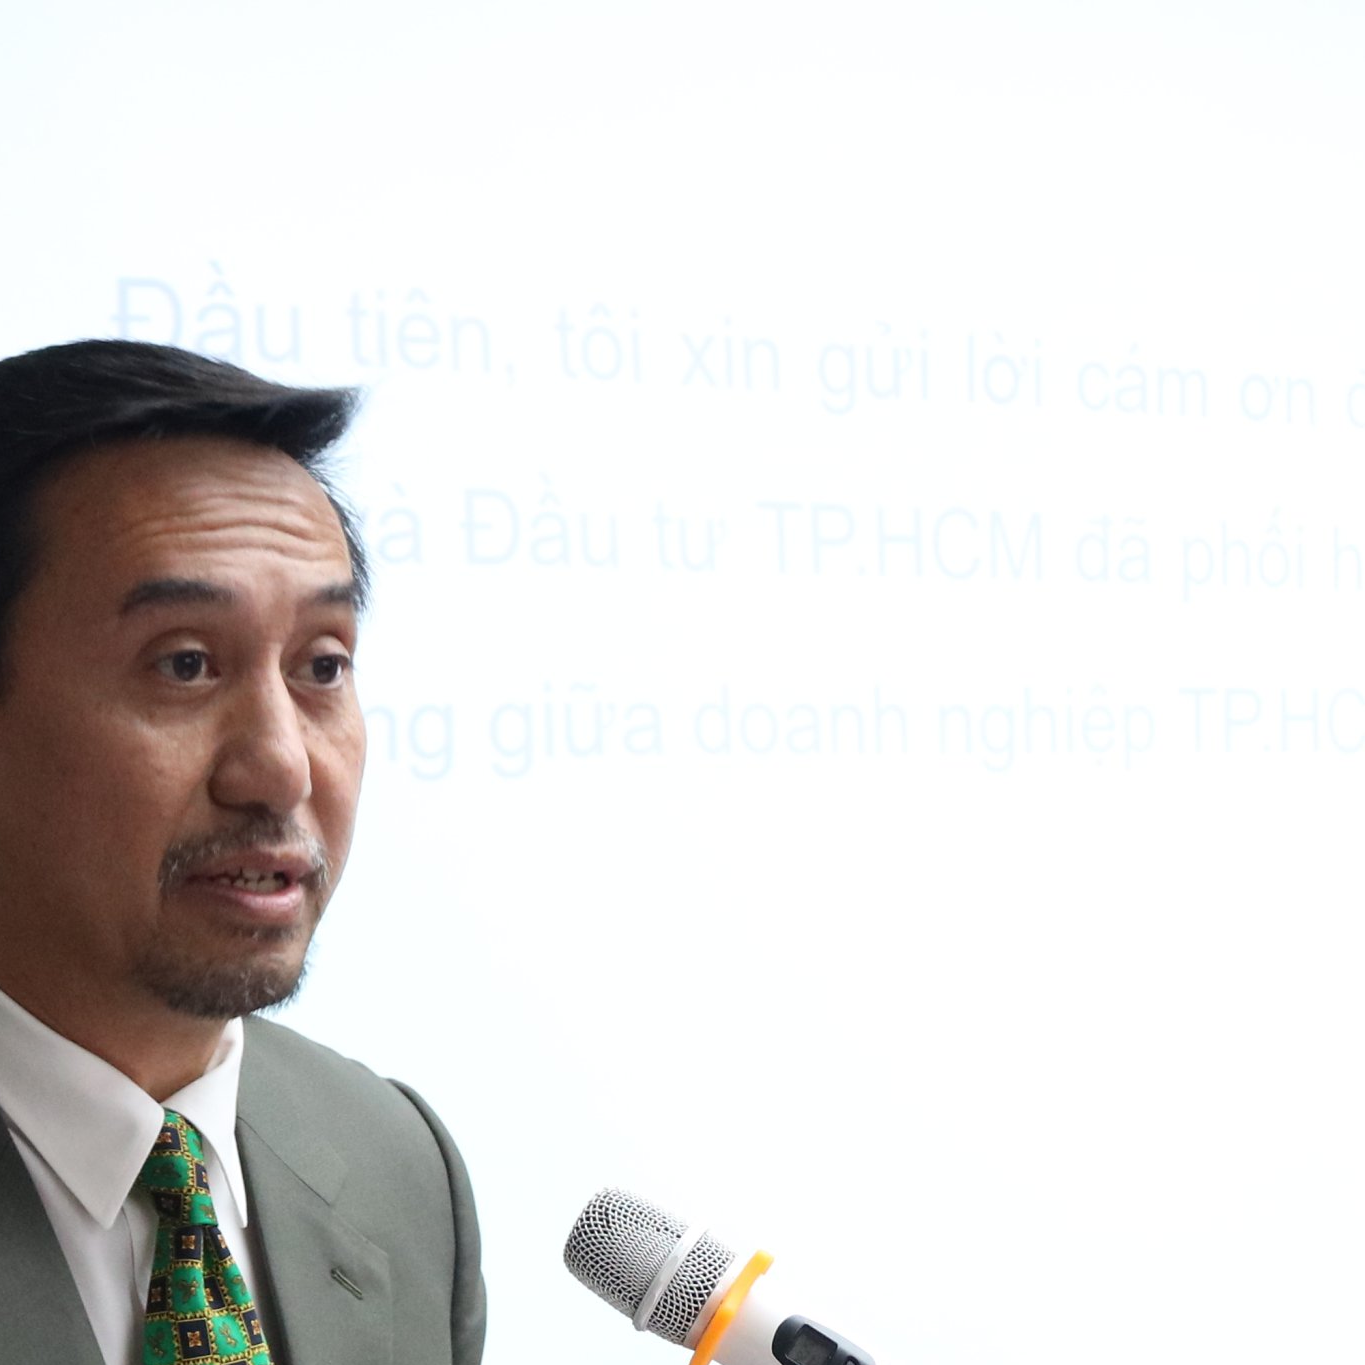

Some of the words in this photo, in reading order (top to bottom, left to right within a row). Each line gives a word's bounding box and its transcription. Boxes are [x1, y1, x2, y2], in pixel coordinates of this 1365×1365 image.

[110, 257, 303, 364] Đầu
[344, 286, 516, 387] tiên,
[554, 302, 642, 384] tôi
[682, 317, 781, 391] xin
[966, 331, 1042, 407] lời
[1239, 373, 1316, 425] ơn
[371, 481, 427, 567] à
[458, 472, 620, 568] Đầu
[651, 500, 726, 573] tư
[755, 500, 1043, 581] TP.HCM
[1075, 514, 1151, 584] đã
[1182, 506, 1304, 603] phối
[488, 680, 665, 781] giữa
[693, 686, 908, 755] doanh
[938, 683, 1156, 773] nghiệp
